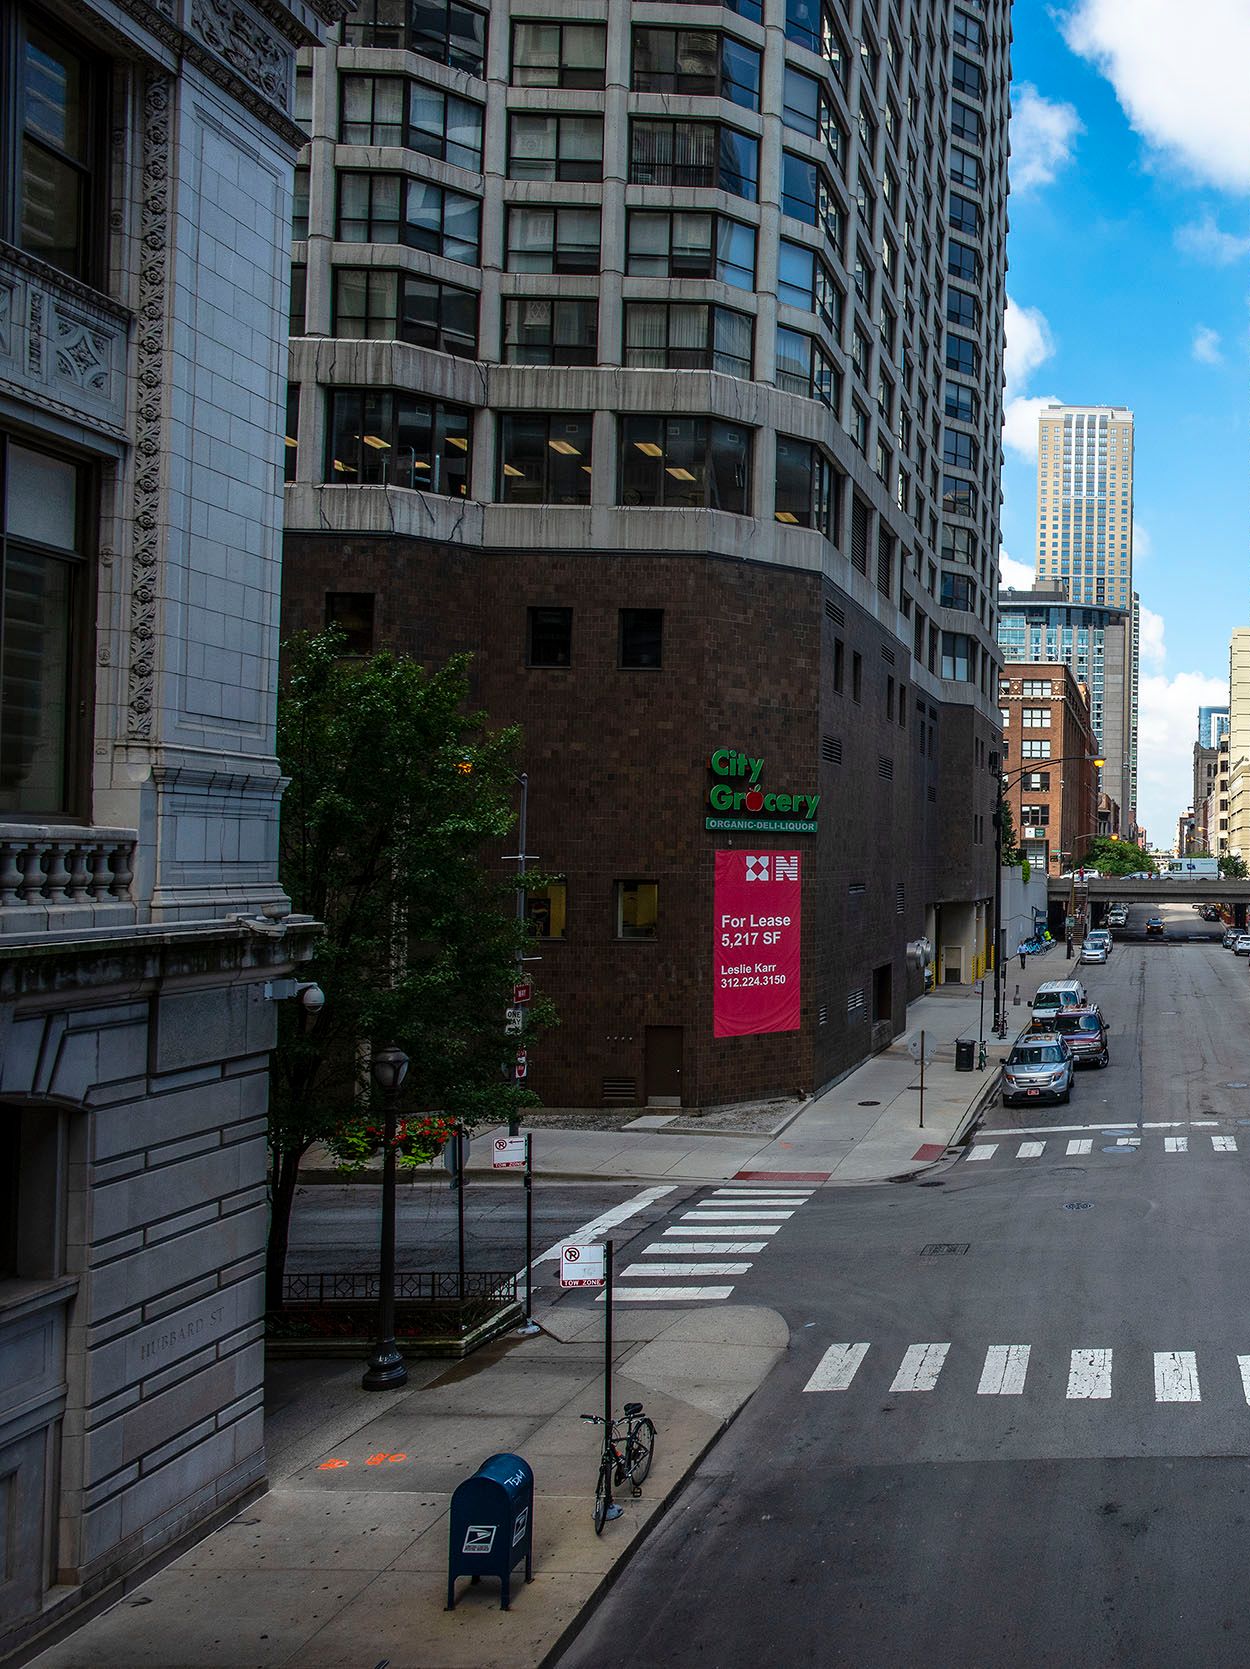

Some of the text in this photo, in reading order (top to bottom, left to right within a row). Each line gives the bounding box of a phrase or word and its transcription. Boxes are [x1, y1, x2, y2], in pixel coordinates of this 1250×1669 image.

[711, 749, 764, 783] City
[722, 915, 791, 928] For Lease
[721, 931, 782, 949] 5,217 SF
[721, 963, 777, 975] Leslie Karr
[720, 974, 787, 989] 312.224.3150
[141, 1306, 225, 1360] HUBBARD ST
